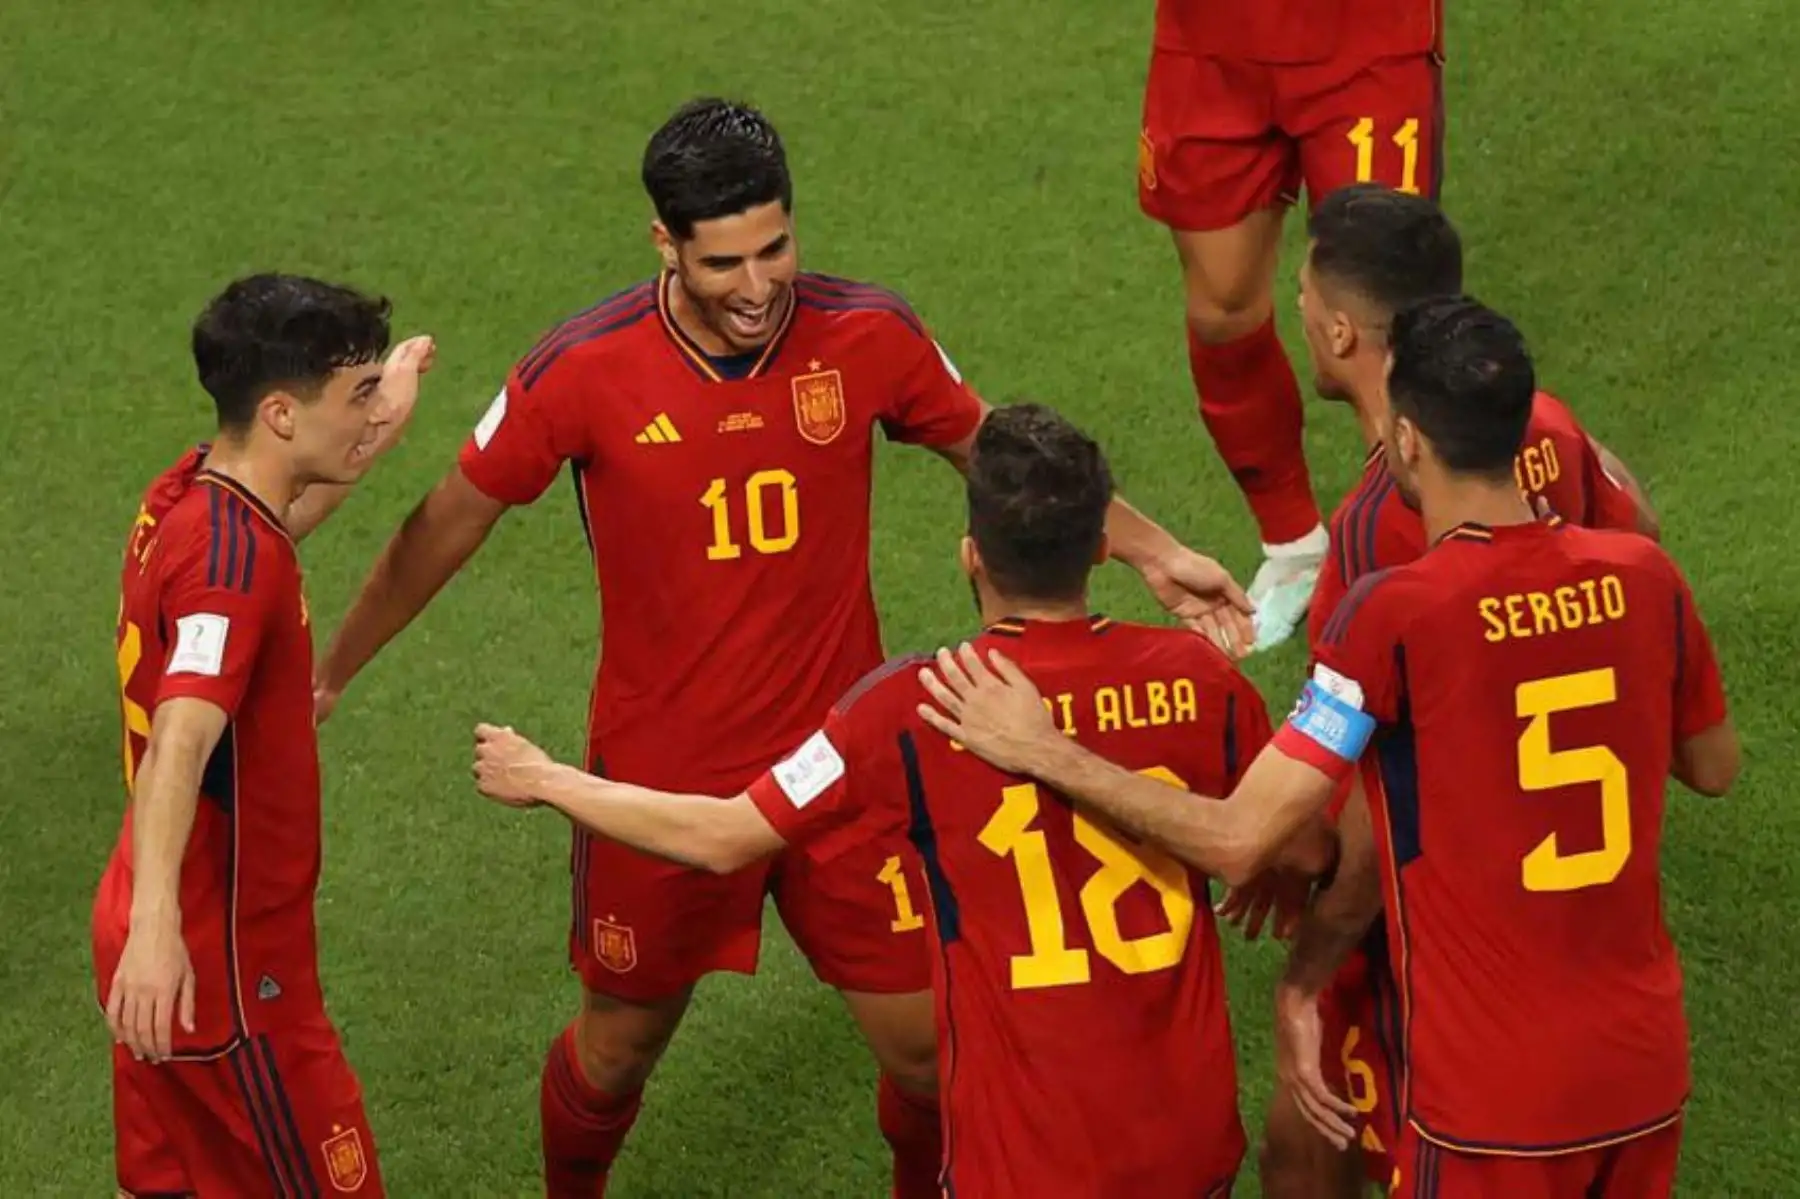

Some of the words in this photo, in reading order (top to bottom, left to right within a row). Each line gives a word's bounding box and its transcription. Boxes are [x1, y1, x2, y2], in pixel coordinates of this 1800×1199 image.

[1346, 116, 1420, 195] 11
[698, 467, 800, 562] 10
[1478, 573, 1627, 643] SERGIO
[1094, 677, 1199, 733] ALBA
[1515, 666, 1632, 892] 5
[977, 765, 1195, 990] 18
[1340, 1025, 1378, 1114] 6
